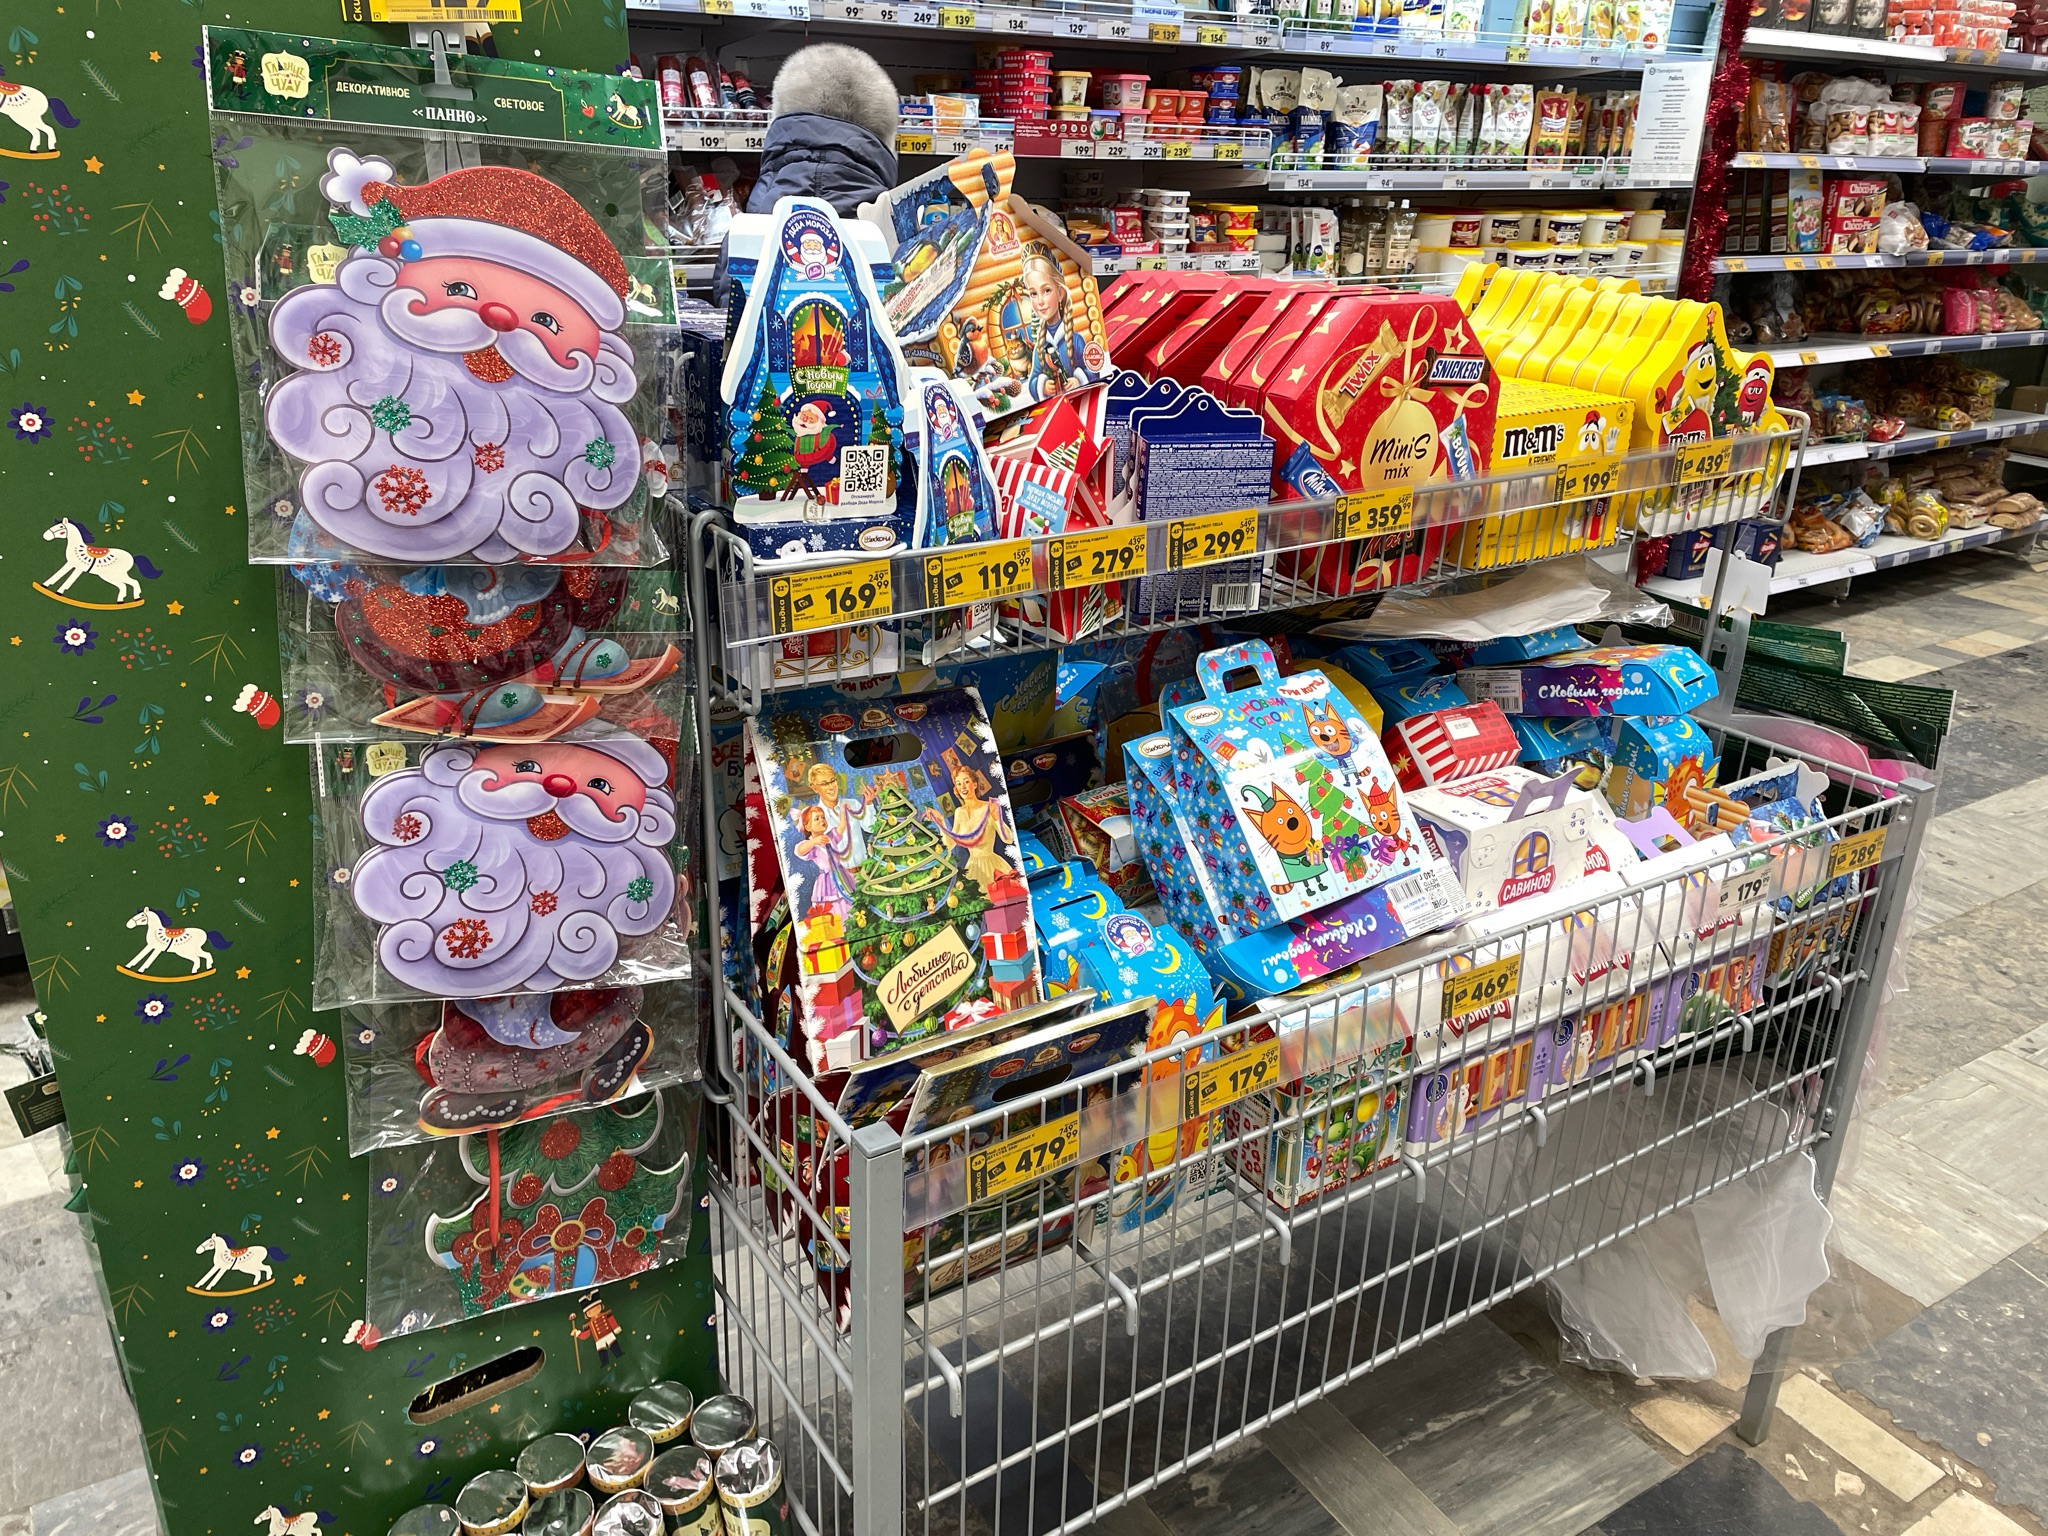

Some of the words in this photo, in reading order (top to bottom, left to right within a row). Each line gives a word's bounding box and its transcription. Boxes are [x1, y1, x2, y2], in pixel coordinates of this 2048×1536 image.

[788, 6, 804, 16] 115
[845, 7, 859, 17] 99
[880, 10, 893, 20] 95
[914, 12, 932, 23] 249
[954, 15, 971, 25] 139
[1008, 19, 1024, 30] 134
[1068, 24, 1084, 34] 129
[1111, 26, 1126, 36] 149
[1162, 30, 1176, 40] 139
[336, 81, 411, 99] ДЕКОРАТИВНОЕ
[493, 96, 545, 112] СВЕТОВОЕ
[699, 136, 719, 147] 109
[744, 137, 763, 148] 134
[910, 141, 928, 151] 109
[952, 142, 967, 152] 119
[1074, 145, 1089, 155] 199
[1108, 146, 1123, 156] 229
[1143, 147, 1158, 156] 229
[1173, 147, 1188, 157] 239
[1225, 149, 1239, 158] 239
[788, 220, 805, 239] ДЕДА
[805, 219, 833, 240] МОРОЗА
[1103, 263, 1115, 272] 94
[1153, 262, 1164, 270] 42
[1180, 262, 1194, 270] 184
[1214, 260, 1228, 269] 129
[1242, 259, 1256, 267] 239
[1430, 359, 1485, 380] SNICKERS
[795, 370, 807, 385] С
[808, 367, 844, 383] Новым
[1452, 436, 1471, 479] BOUN
[1695, 453, 1724, 475] 439
[1383, 463, 1410, 480] mix
[1582, 471, 1610, 494] 199
[1366, 503, 1403, 530] 359
[1402, 502, 1412, 511] 99
[1240, 521, 1252, 529] 549
[1128, 537, 1142, 546] 439
[1203, 528, 1245, 557] 299
[1245, 526, 1255, 536] 99
[1013, 551, 1026, 560] 159
[1091, 546, 1134, 576] 279
[1134, 543, 1145, 554] 99
[869, 573, 885, 582] 249
[978, 561, 1019, 591] 119
[1019, 558, 1031, 567] 99
[824, 582, 877, 615] 169
[876, 580, 889, 590] 99
[779, 599, 787, 634] Скидка
[1538, 685, 1549, 699] С
[1550, 683, 1599, 699] Новым
[1600, 682, 1651, 700] годом!
[1237, 697, 1289, 717] НОВЫМ
[1849, 844, 1877, 867] 289
[1503, 872, 1552, 902] САВИНОВ
[1737, 879, 1762, 902] 179
[887, 951, 952, 1005] Любимые
[912, 951, 970, 1017] детства
[1470, 973, 1509, 1002] 469
[1261, 1050, 1275, 1060] 299
[1228, 1060, 1268, 1092] 179
[1268, 1055, 1279, 1065] 99
[1059, 1125, 1074, 1135] 749
[1015, 1136, 1066, 1173] 479
[1065, 1129, 1079, 1140] 99
